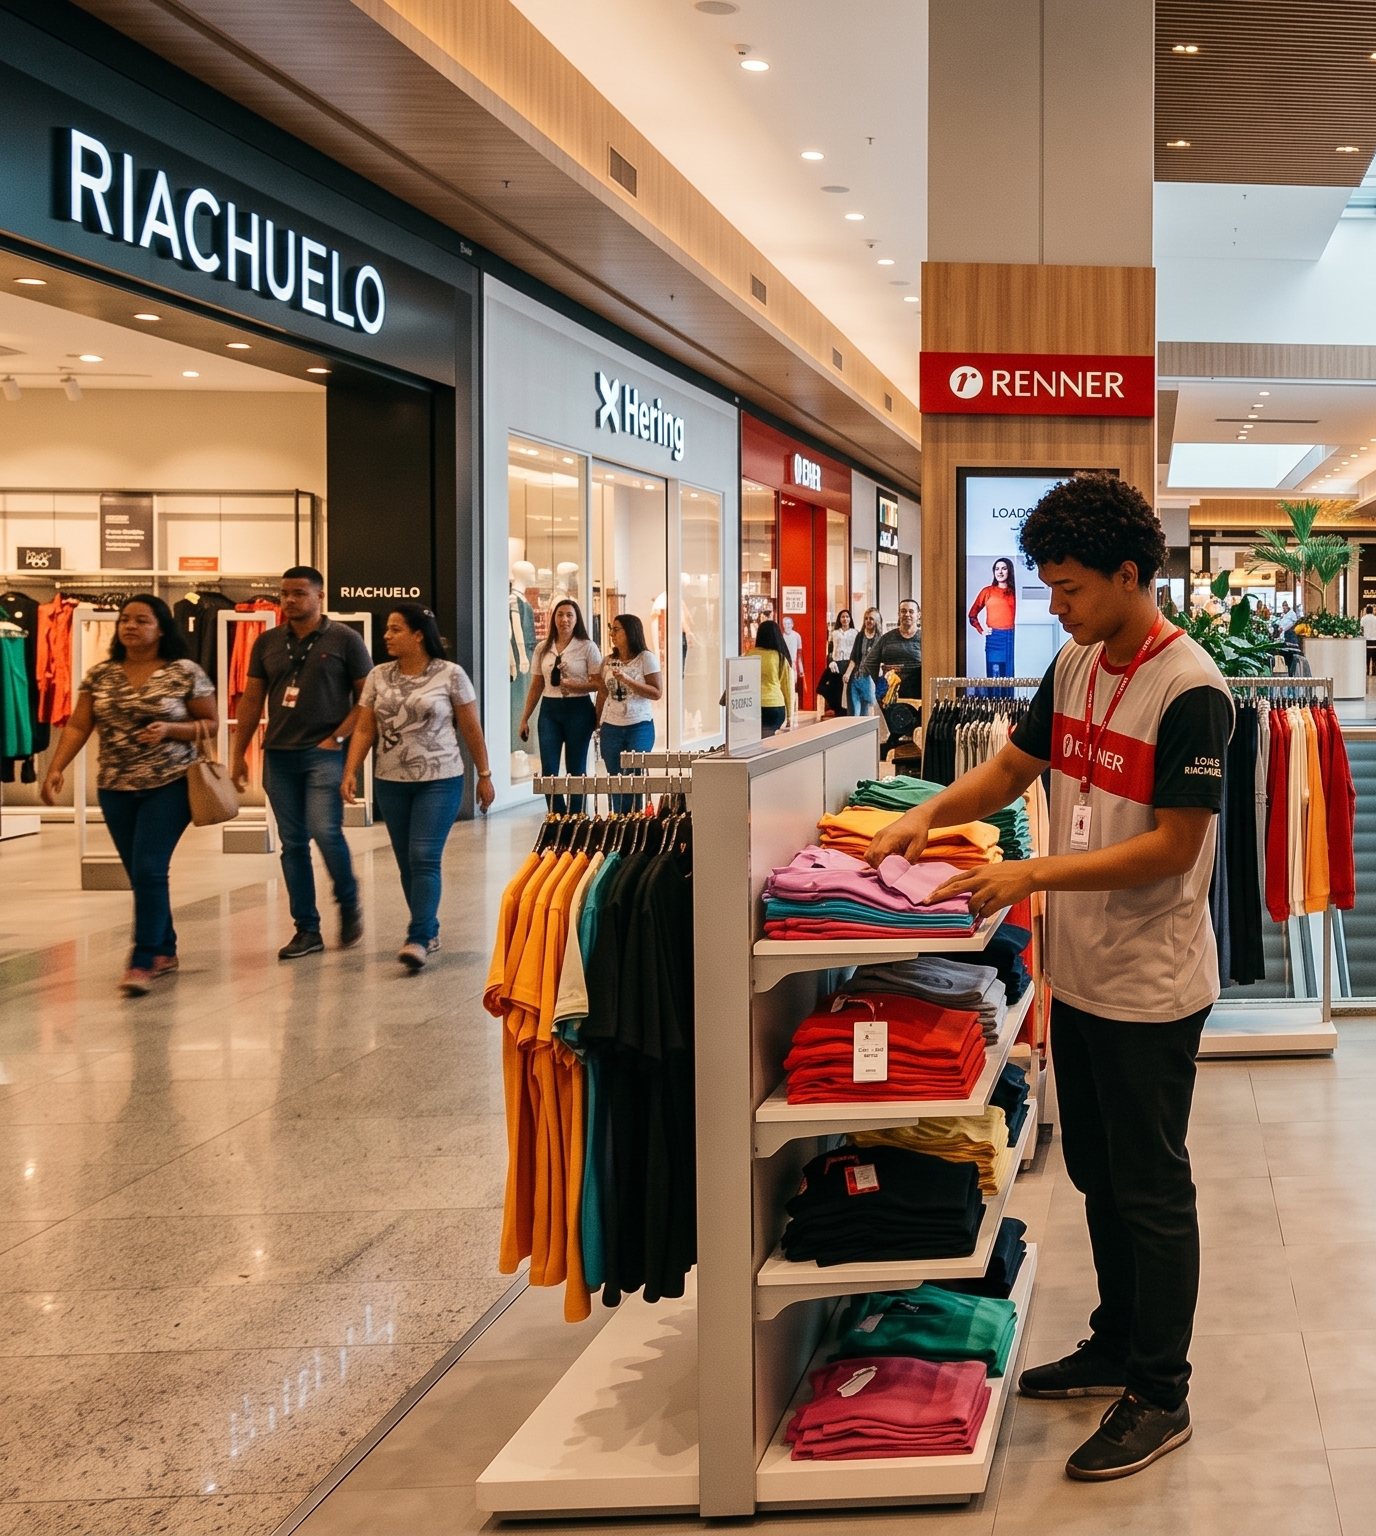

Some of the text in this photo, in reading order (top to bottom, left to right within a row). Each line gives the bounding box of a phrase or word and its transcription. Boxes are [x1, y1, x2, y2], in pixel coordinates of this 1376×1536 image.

[69, 128, 386, 335] RIACHUELO
[992, 370, 1125, 398] RENNER
[624, 384, 685, 462] Hering
[340, 587, 421, 598] RIACHUELO
[1194, 757, 1220, 767] LOJAS
